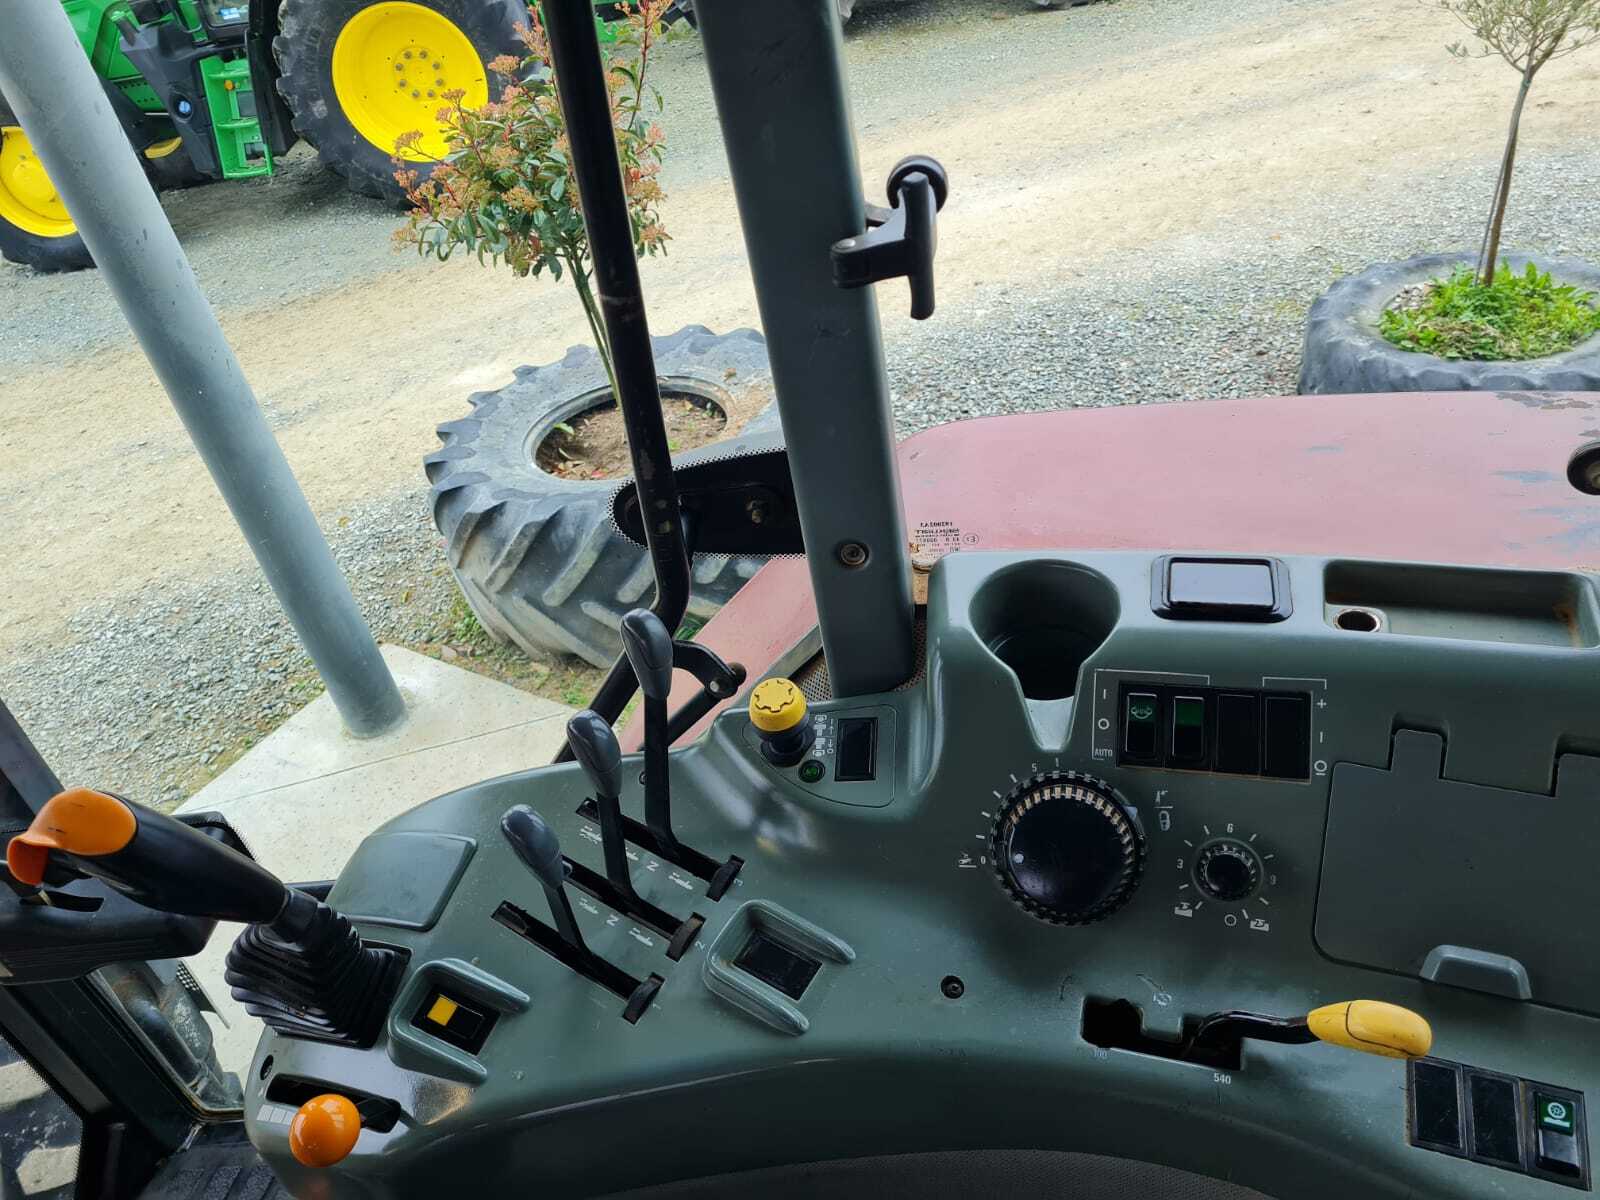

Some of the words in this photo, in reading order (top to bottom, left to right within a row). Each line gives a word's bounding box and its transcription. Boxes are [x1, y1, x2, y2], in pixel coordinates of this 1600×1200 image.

[1094, 748, 1113, 757] AUTO
[1226, 823, 1234, 833] 6
[1176, 858, 1184, 869] 3
[1213, 1073, 1231, 1085] 540
